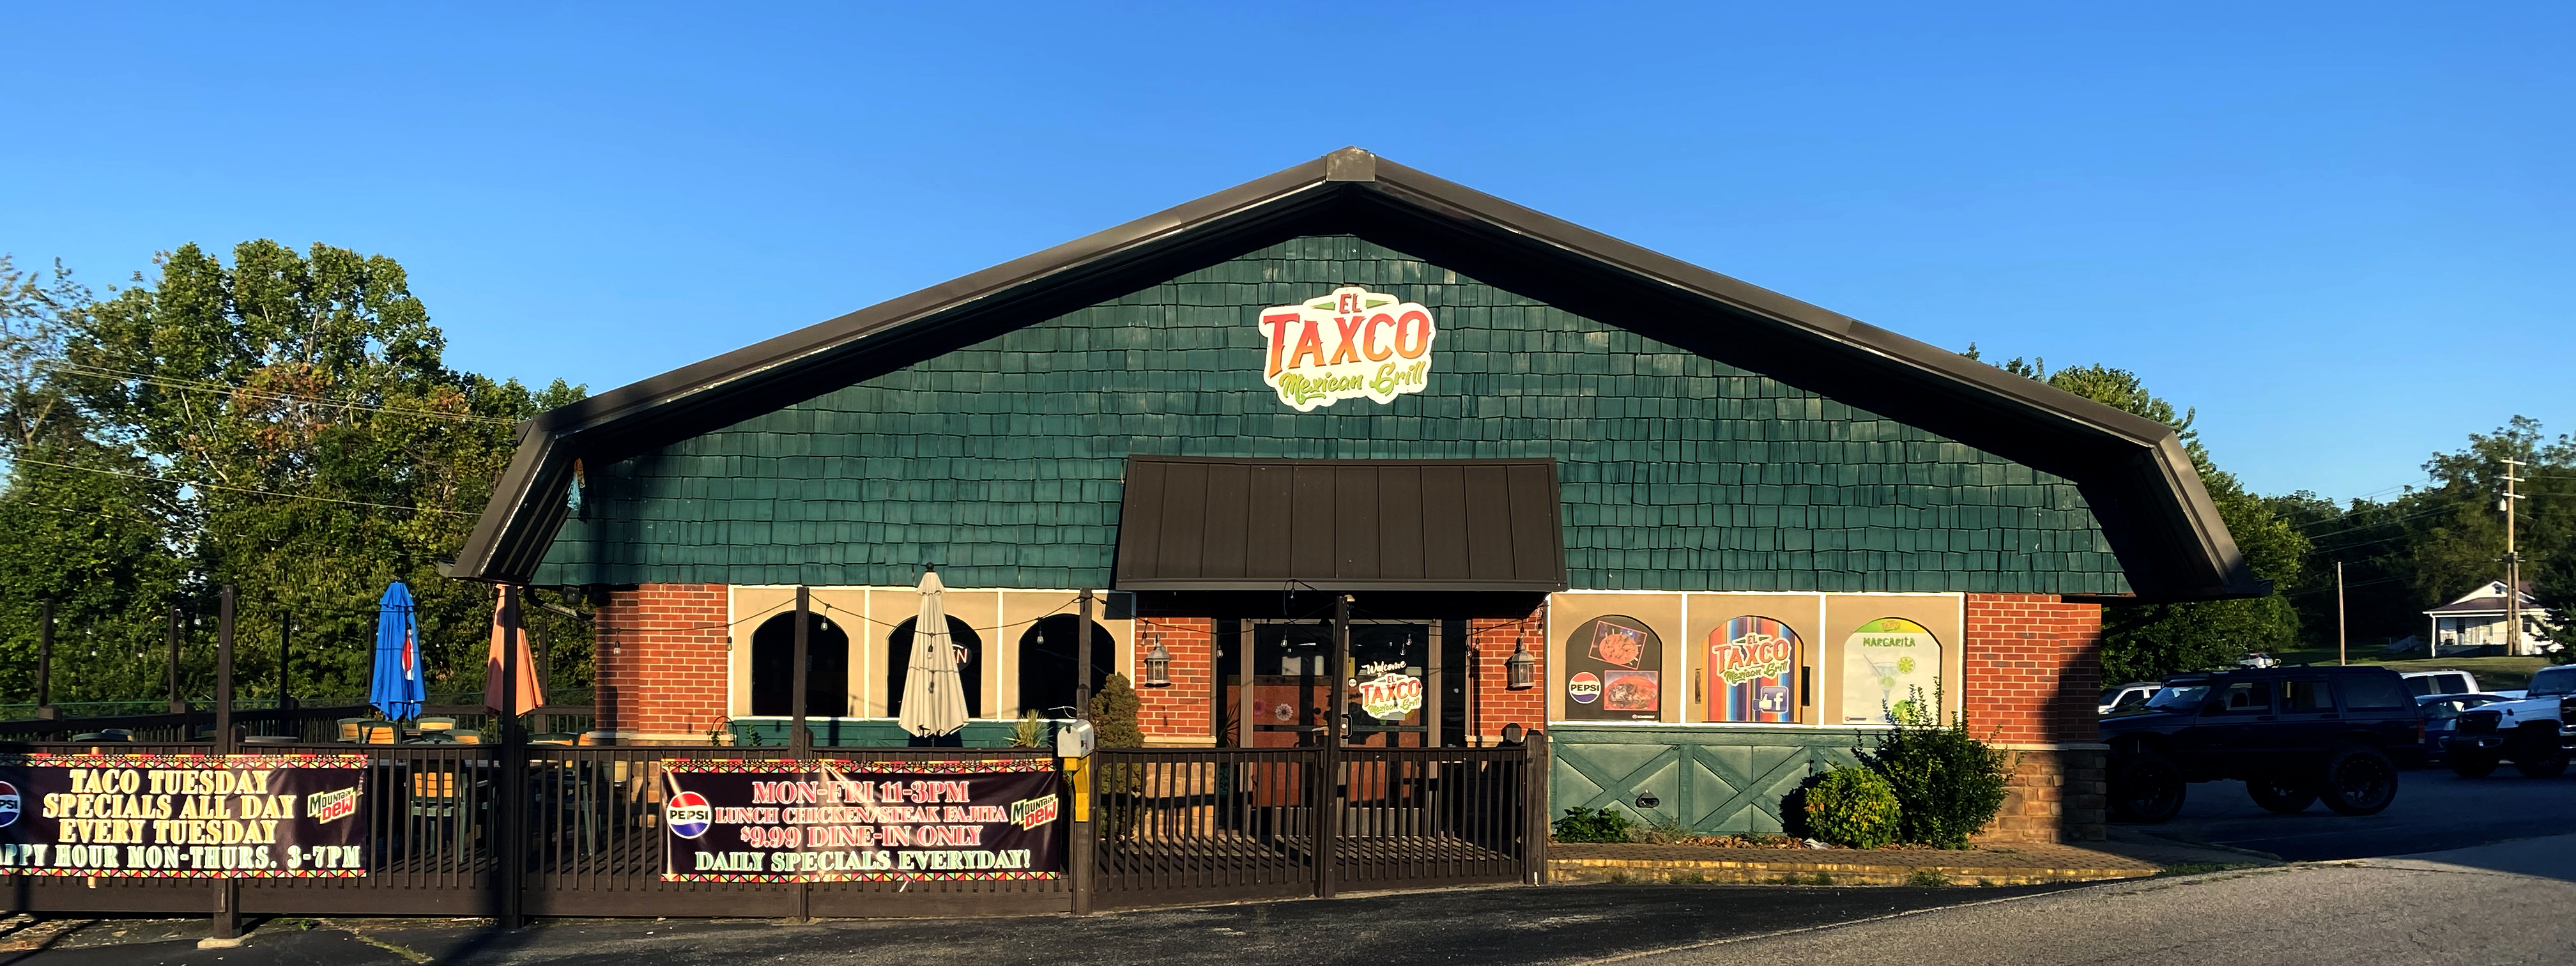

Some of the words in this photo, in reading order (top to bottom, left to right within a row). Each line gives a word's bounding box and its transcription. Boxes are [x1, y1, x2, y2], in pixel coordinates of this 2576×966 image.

[1339, 293, 1362, 314] EL
[1263, 310, 1431, 378] TAXCO
[1278, 372, 1364, 405] Mexican
[1369, 361, 1426, 397] Grill
[1747, 635, 1758, 644] EL
[1863, 636, 1915, 647] MARGARITA
[1361, 661, 1406, 674] Welcome
[1714, 640, 1788, 674] TAXCO
[1724, 669, 1761, 684] Mexican
[1764, 660, 1788, 677] Grill
[1360, 680, 1421, 707] TAXCO
[1368, 703, 1398, 716] Mexican
[1400, 697, 1420, 710] Grill
[70, 769, 140, 794] TACO
[148, 770, 271, 795] TUESDAY
[752, 781, 875, 804] MON-FRI
[880, 781, 970, 803] 11-3PM
[0, 799, 18, 809] PSI
[43, 793, 172, 819] SPECIALS
[179, 795, 231, 819] ALL
[240, 795, 296, 819] DAY
[670, 810, 709, 820] PEPSI
[715, 807, 779, 824] LUNCH
[782, 806, 940, 824] CHICKEN/STEAK
[943, 805, 1009, 822] FAJITA
[58, 818, 146, 843] EVERY
[153, 820, 279, 845] TUESDAY
[740, 826, 801, 848] $9.99
[807, 825, 911, 848] DINE-IN
[916, 825, 983, 847] ONLY
[0, 844, 48, 866] PPY
[54, 845, 119, 868] HOUR
[127, 845, 277, 869] MON-THURS.
[288, 845, 360, 869] 3-7PM
[695, 852, 765, 871] DAILY
[771, 851, 891, 871] SPECIALS
[898, 848, 1031, 870] EVERYDAY!
